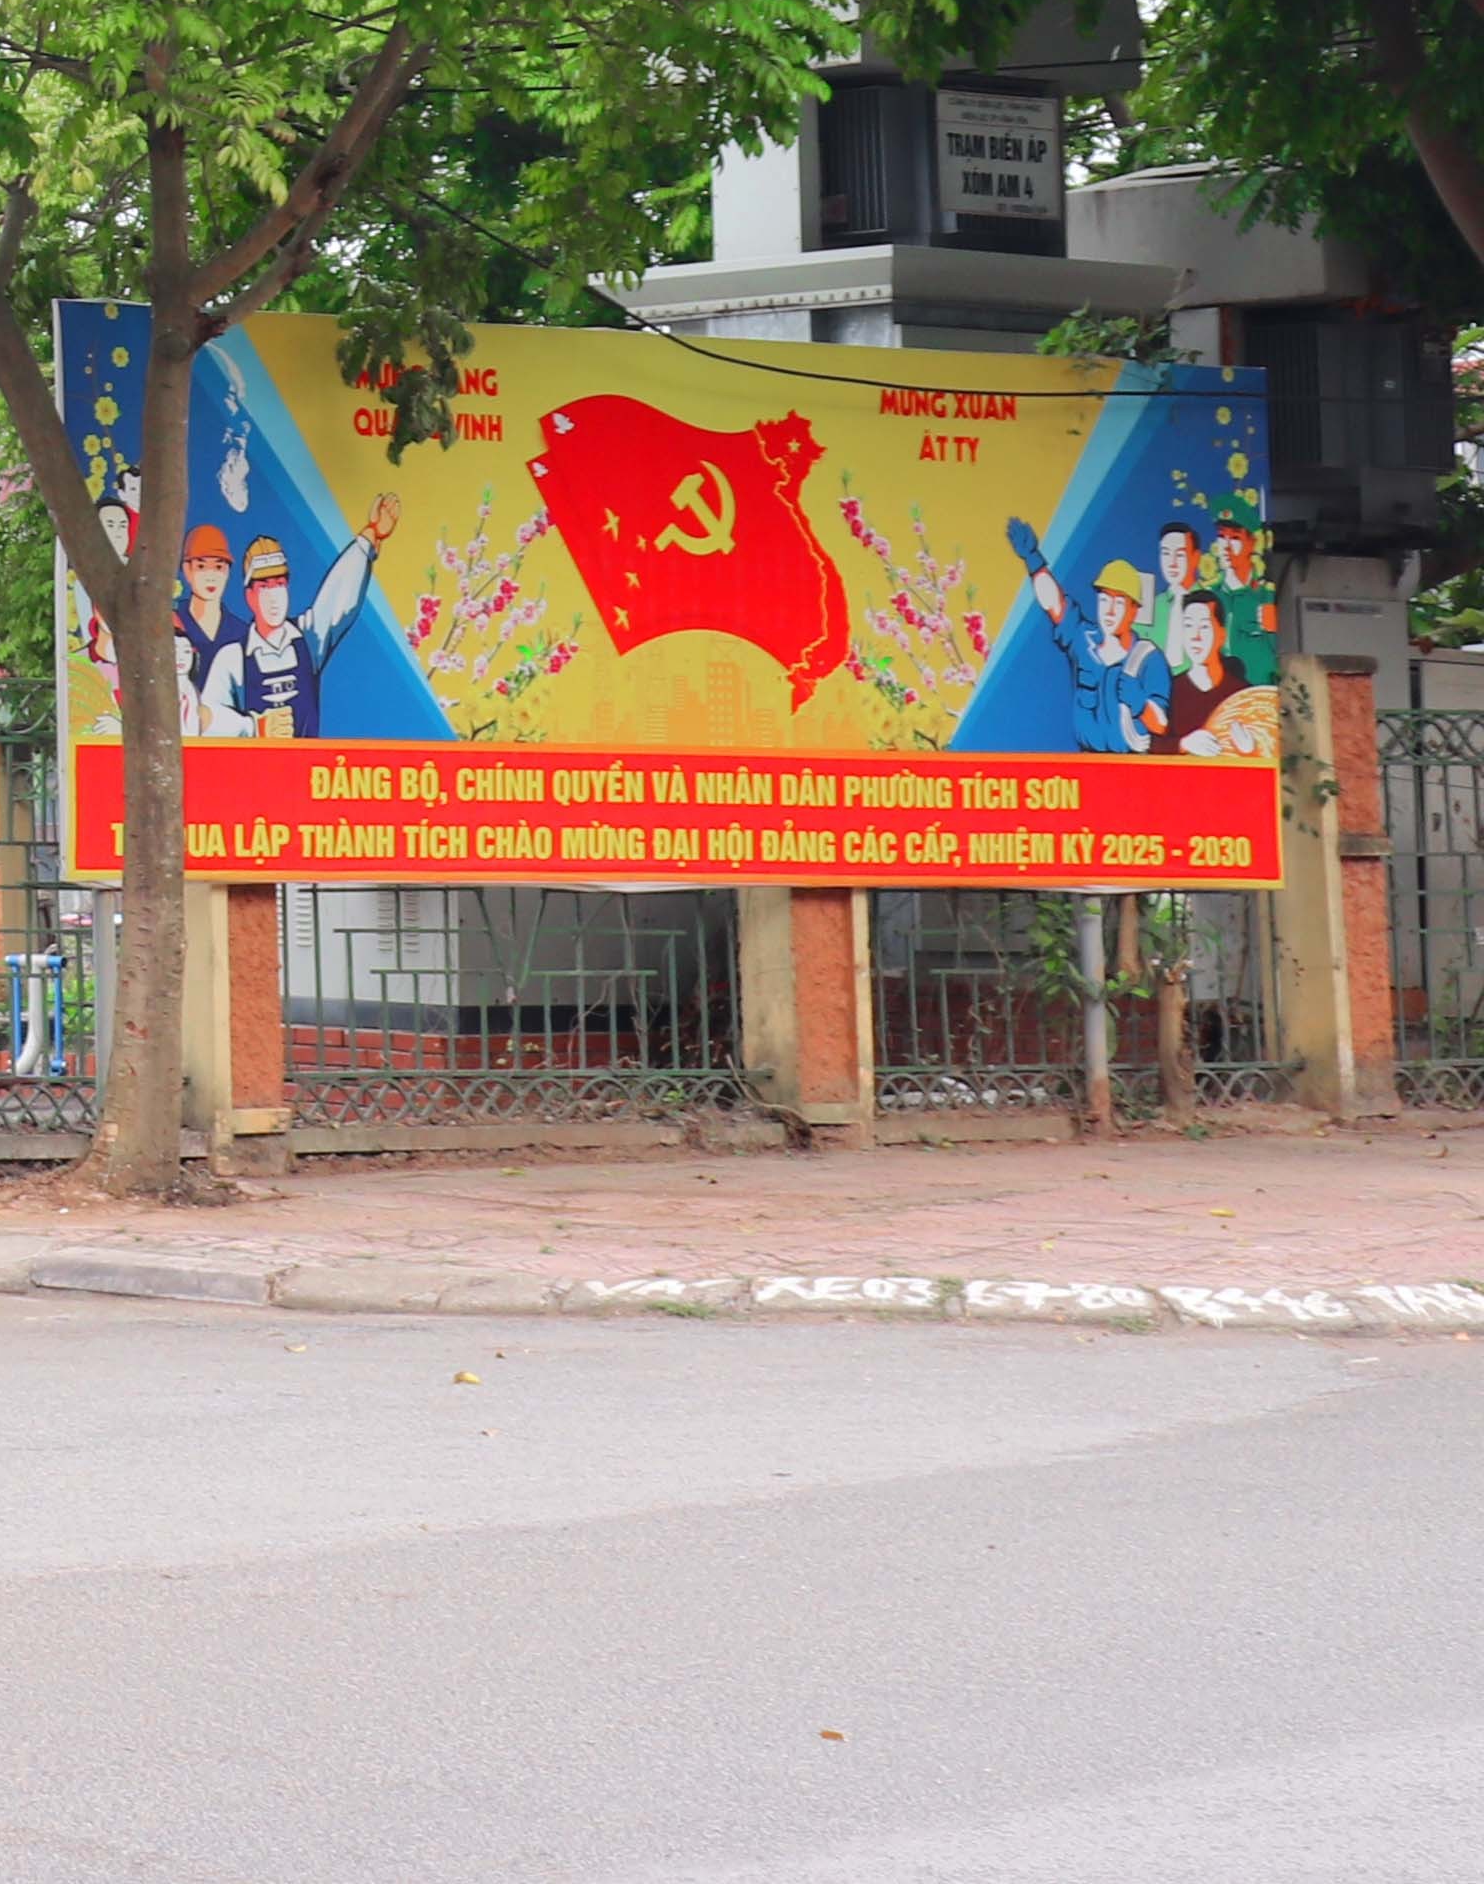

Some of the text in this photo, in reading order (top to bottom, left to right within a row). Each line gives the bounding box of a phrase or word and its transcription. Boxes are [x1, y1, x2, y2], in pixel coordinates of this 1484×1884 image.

[310, 755, 1081, 810] ĐẢNG BỘ, CHÍNH QUYỀN VÀ NHÂN DÂN PHƯỜNG TÍCH SƠN
[234, 816, 291, 865] LẬP
[298, 817, 395, 858] THÀNH
[402, 818, 468, 859] TÍCH
[475, 819, 553, 860] CHÀO
[560, 819, 646, 861] MỪNG
[652, 827, 700, 868] ĐẠI
[707, 822, 754, 868] HỘI
[760, 820, 836, 863] ĐẢNG
[843, 825, 898, 864] CÁC
[904, 821, 962, 868] CẤP,
[968, 826, 1055, 871] NHIỆM
[1062, 827, 1096, 865] KỲ
[1101, 834, 1165, 866] 2025
[1171, 848, 1184, 856] -
[1188, 836, 1252, 868] 2030
